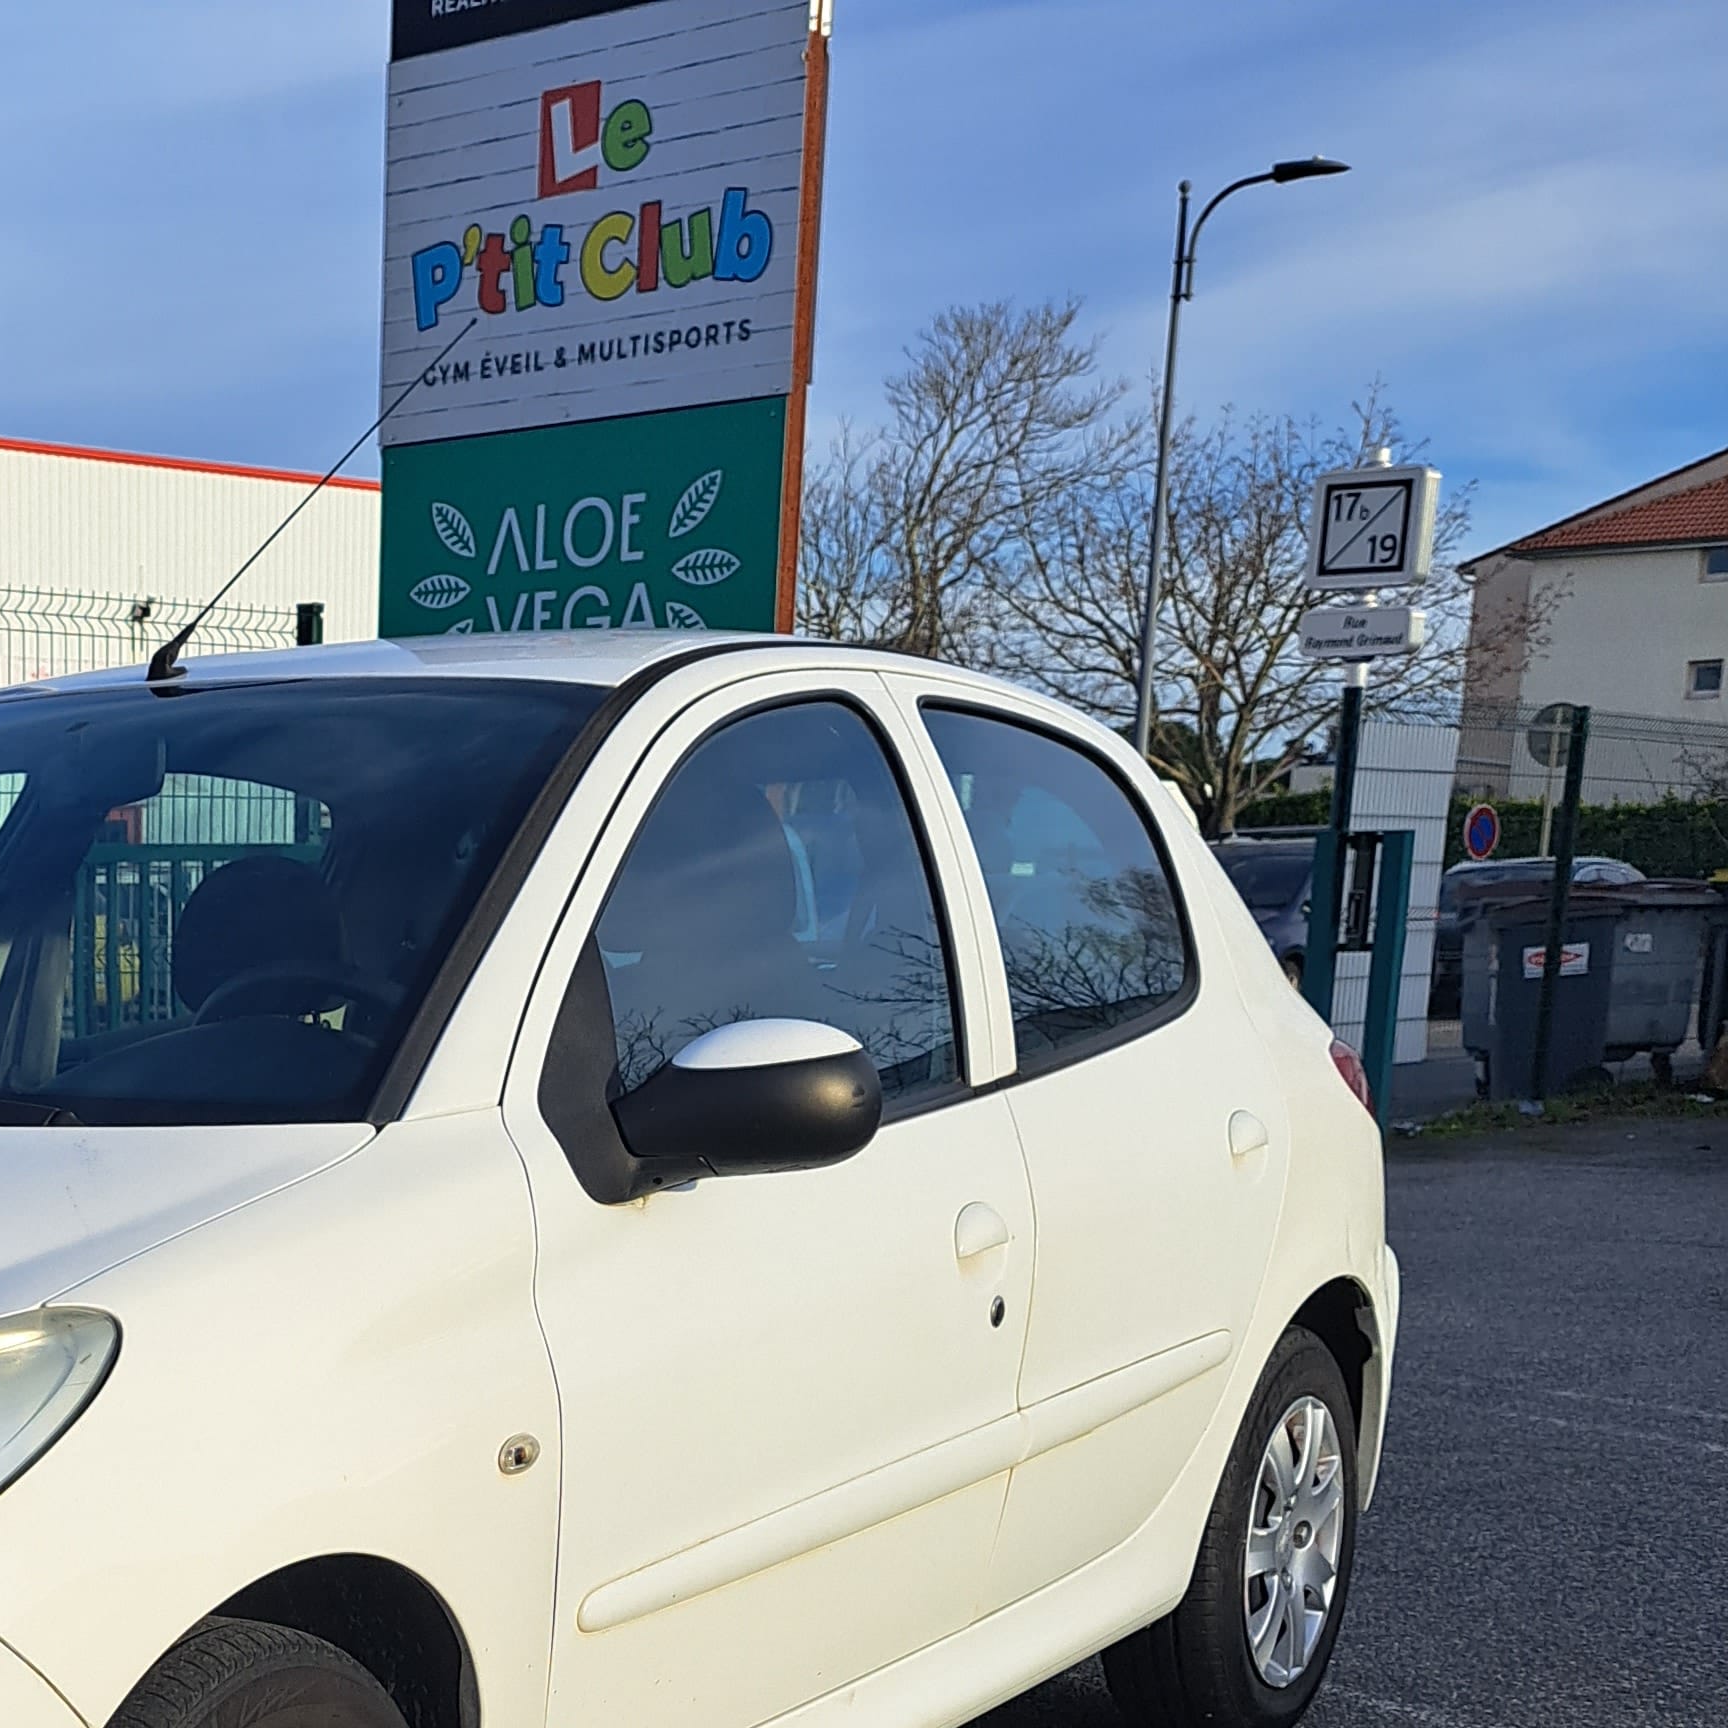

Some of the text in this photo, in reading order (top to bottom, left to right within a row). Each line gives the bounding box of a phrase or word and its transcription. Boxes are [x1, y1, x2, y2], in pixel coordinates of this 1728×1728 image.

[537, 80, 653, 199] Le
[411, 187, 773, 331] P'tit Club
[422, 319, 752, 388] GYM ÉVEIL & MULTISPORTS
[486, 492, 647, 576] ALOE
[1367, 534, 1398, 564] 19
[485, 583, 657, 632] VEGA
[1342, 615, 1369, 630] Rue
